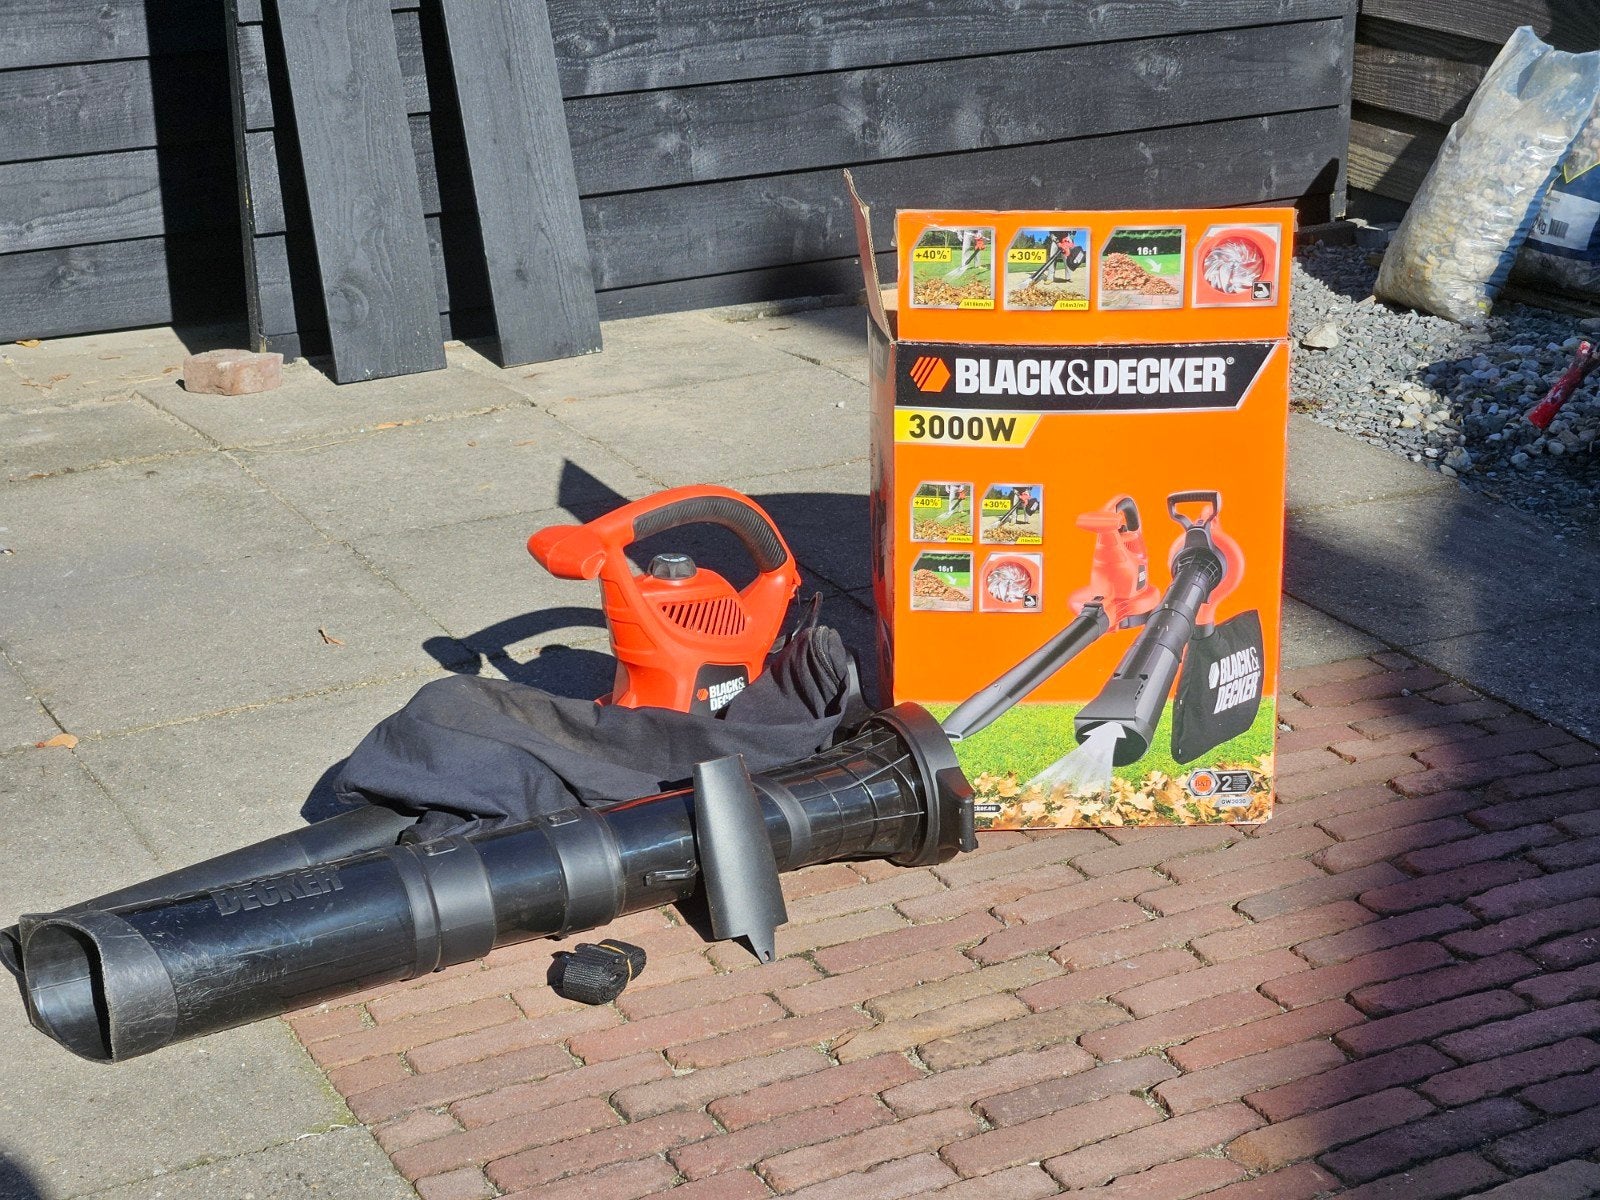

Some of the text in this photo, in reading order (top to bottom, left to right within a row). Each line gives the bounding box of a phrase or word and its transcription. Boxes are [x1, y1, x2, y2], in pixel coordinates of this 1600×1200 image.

[1136, 246, 1158, 255] 16:1
[909, 413, 1017, 442] 3000W
[938, 565, 954, 573] 16:1
[1219, 646, 1260, 686] BLACK&
[708, 676, 746, 699] BLACK&
[709, 689, 743, 711] DECK
[1221, 775, 1232, 791] 2
[210, 866, 344, 917] DECKER
